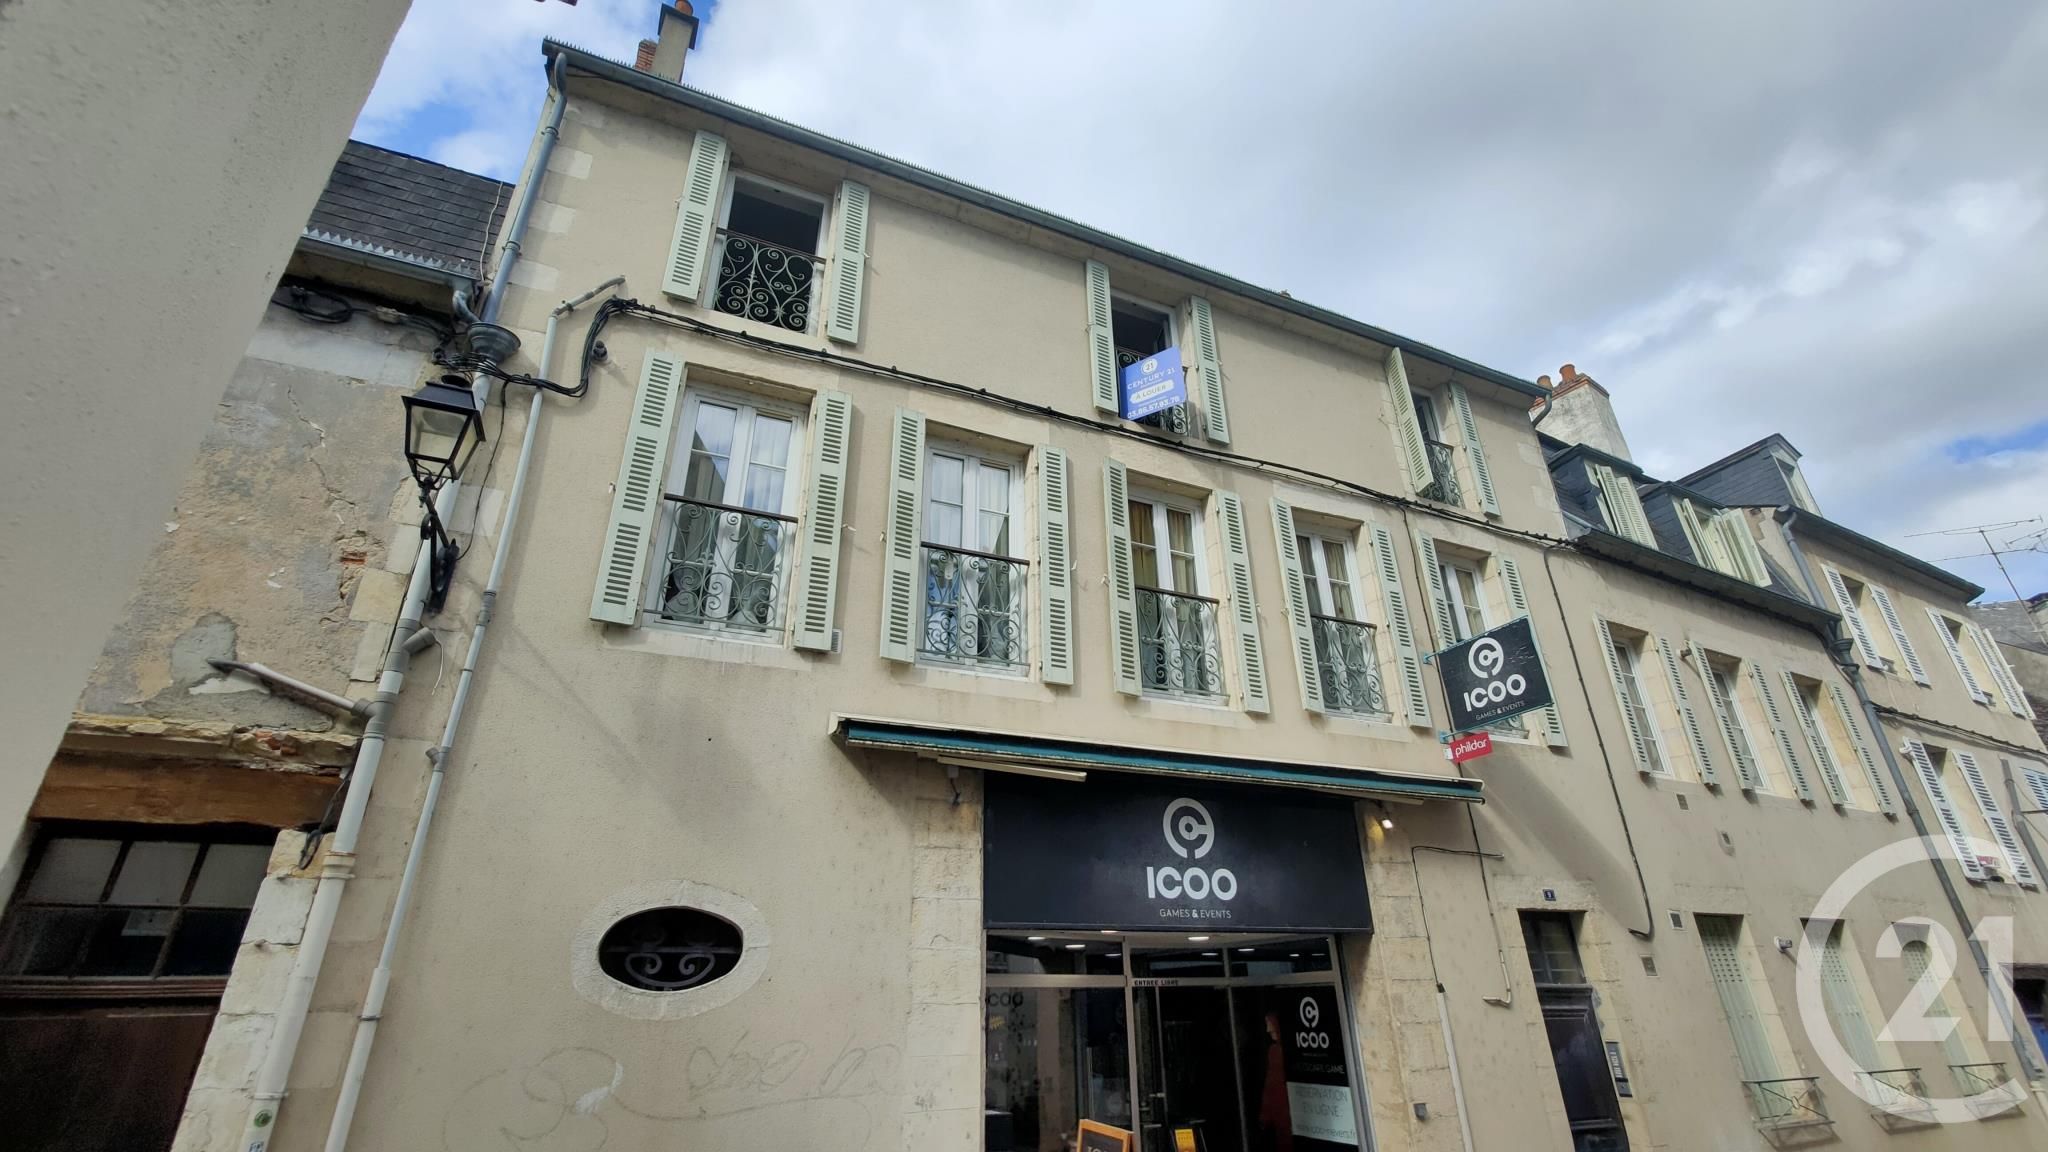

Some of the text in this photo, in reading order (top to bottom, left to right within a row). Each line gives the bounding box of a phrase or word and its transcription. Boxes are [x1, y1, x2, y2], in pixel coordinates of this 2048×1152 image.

[1127, 371, 1165, 390] CENTURY
[1166, 367, 1175, 375] 21
[1463, 673, 1526, 712] ICOO
[1475, 709, 1496, 721] GAMES
[1502, 700, 1526, 712] EVENTS
[1455, 739, 1487, 758] phildar
[1146, 866, 1238, 901] ICOO
[1159, 908, 1233, 920] GAMES & EVENTS
[1296, 1031, 1330, 1049] ICOO
